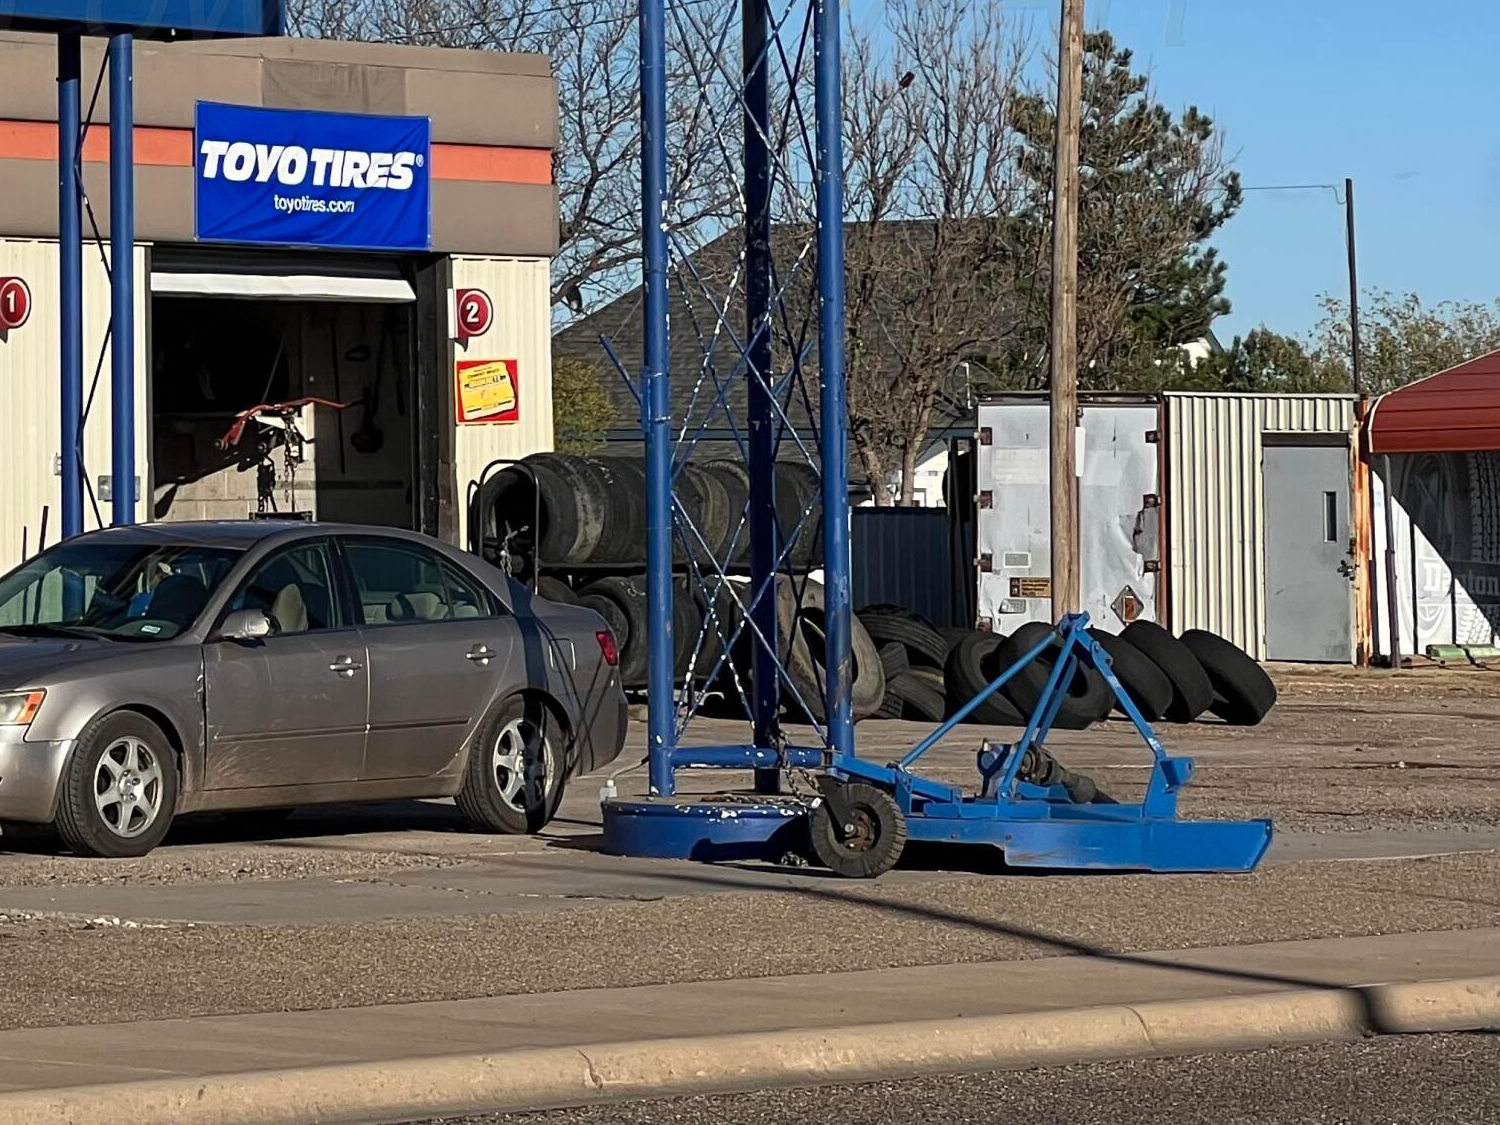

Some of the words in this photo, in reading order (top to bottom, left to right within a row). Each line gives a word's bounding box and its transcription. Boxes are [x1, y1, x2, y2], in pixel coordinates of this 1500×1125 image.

[274, 195, 355, 214] toyotires.com
[6, 289, 16, 313] 1
[466, 301, 480, 323] 2
